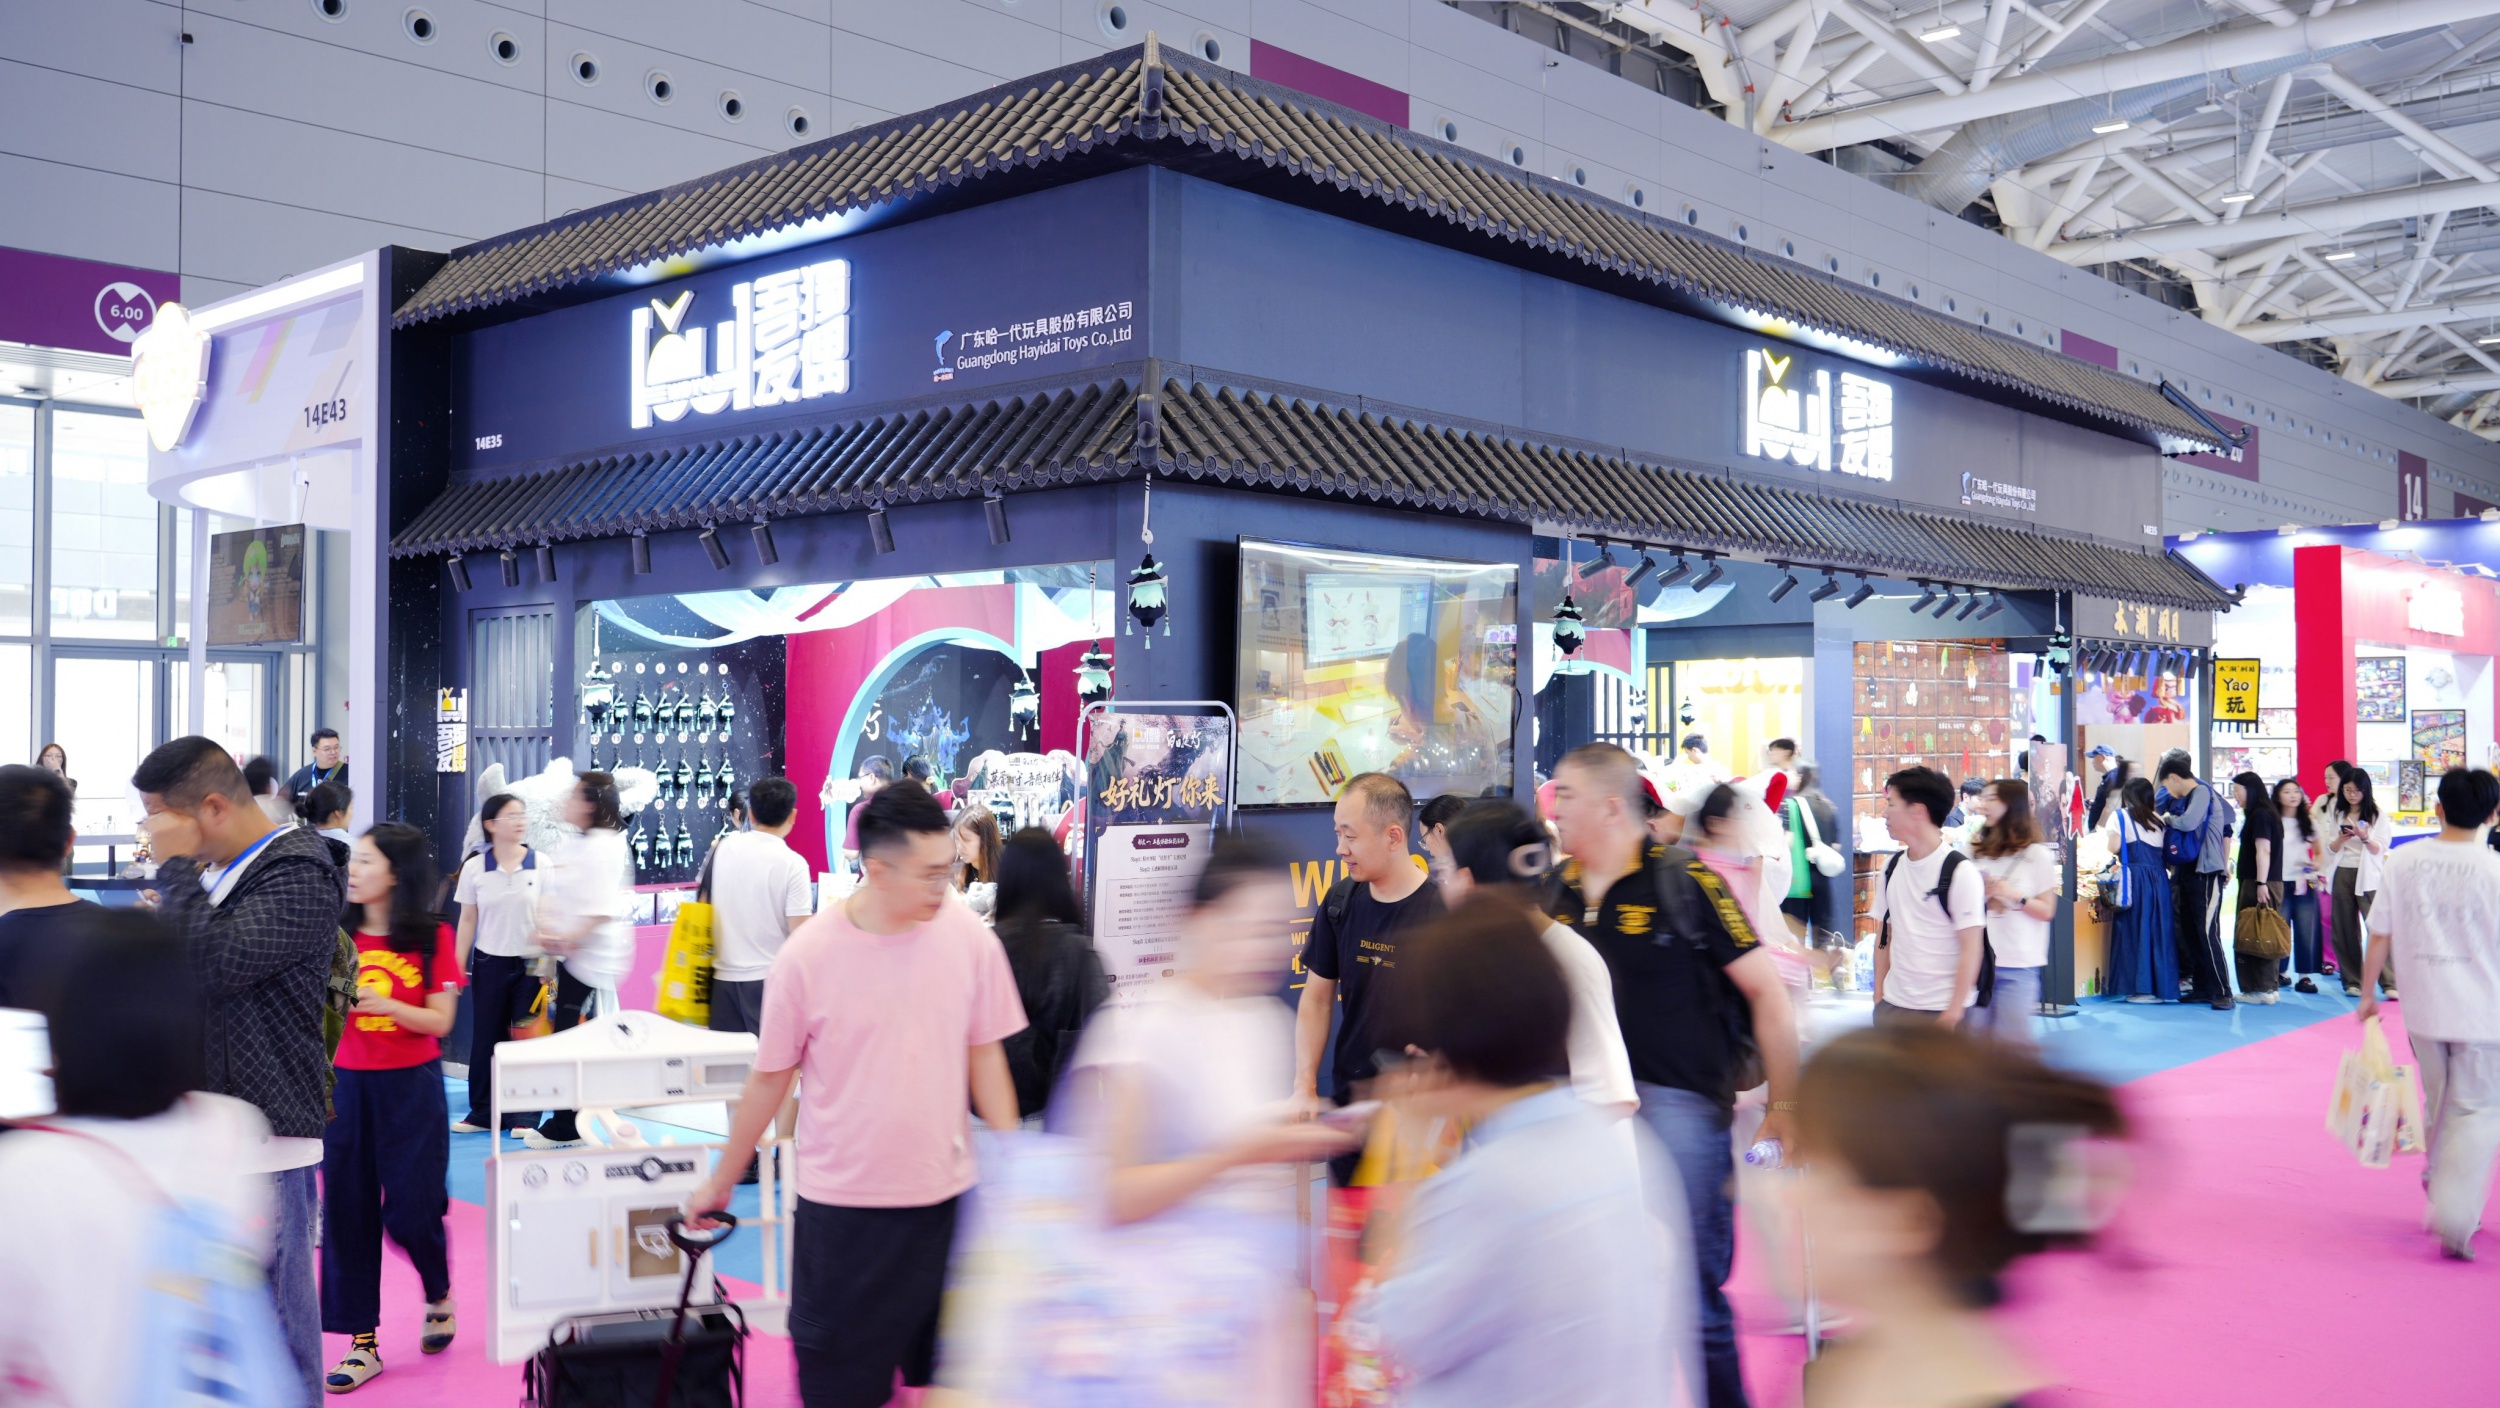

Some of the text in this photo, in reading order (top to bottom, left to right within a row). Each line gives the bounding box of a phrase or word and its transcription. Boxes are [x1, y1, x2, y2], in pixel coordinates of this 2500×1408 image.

[110, 305, 144, 321] 6.00
[960, 301, 1133, 350] 广东哈一代玩具股份有限公司
[957, 349, 1018, 370] Guangdong
[1019, 338, 1061, 361] Hayidai
[1062, 334, 1089, 352] Toys
[304, 399, 346, 428] 14E43
[475, 434, 503, 450] 14E35
[2404, 473, 2423, 521] 14
[2222, 678, 2250, 691] Yao
[2226, 695, 2246, 713] 玩
[1360, 940, 1396, 953] DILIGENT
